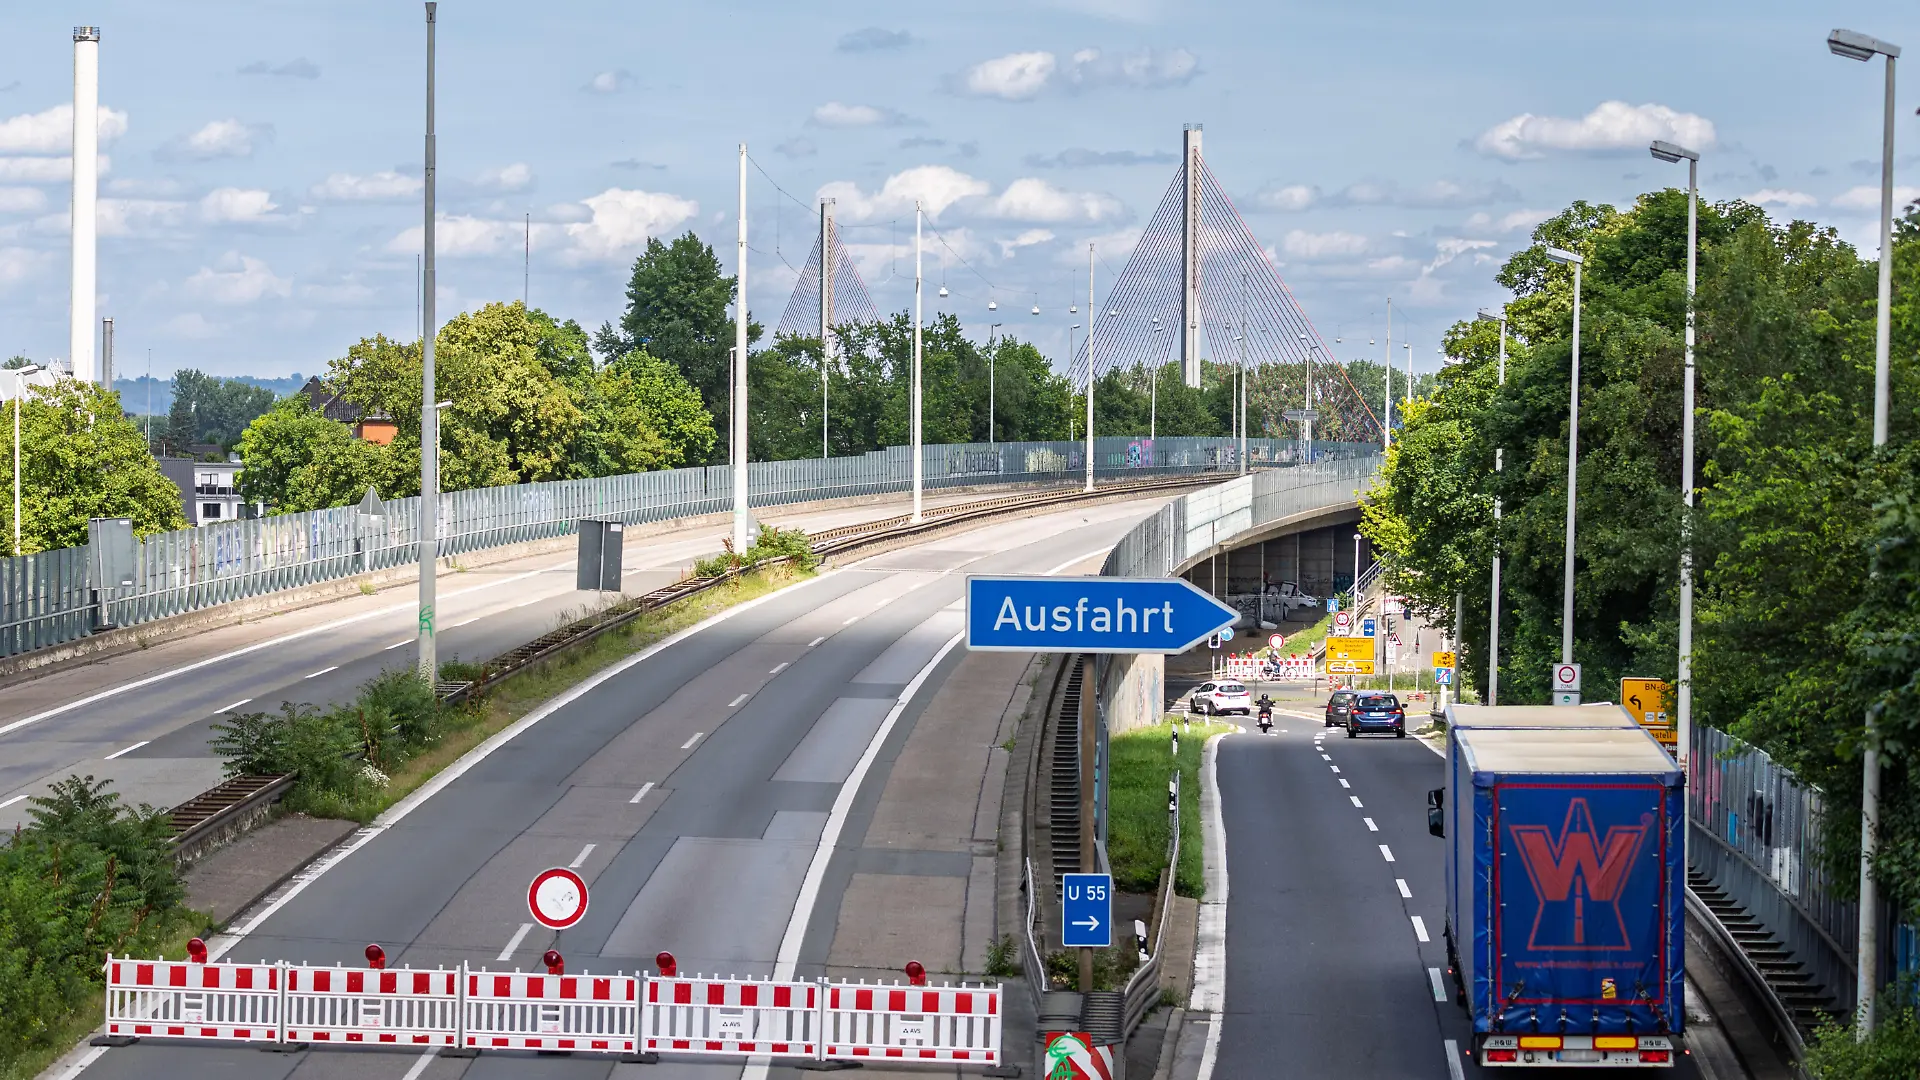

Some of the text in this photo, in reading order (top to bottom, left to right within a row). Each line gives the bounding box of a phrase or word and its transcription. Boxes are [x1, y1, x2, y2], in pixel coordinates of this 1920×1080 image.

[993, 596, 1174, 633] Ausfahrt
[1068, 885, 1106, 901] U 55
